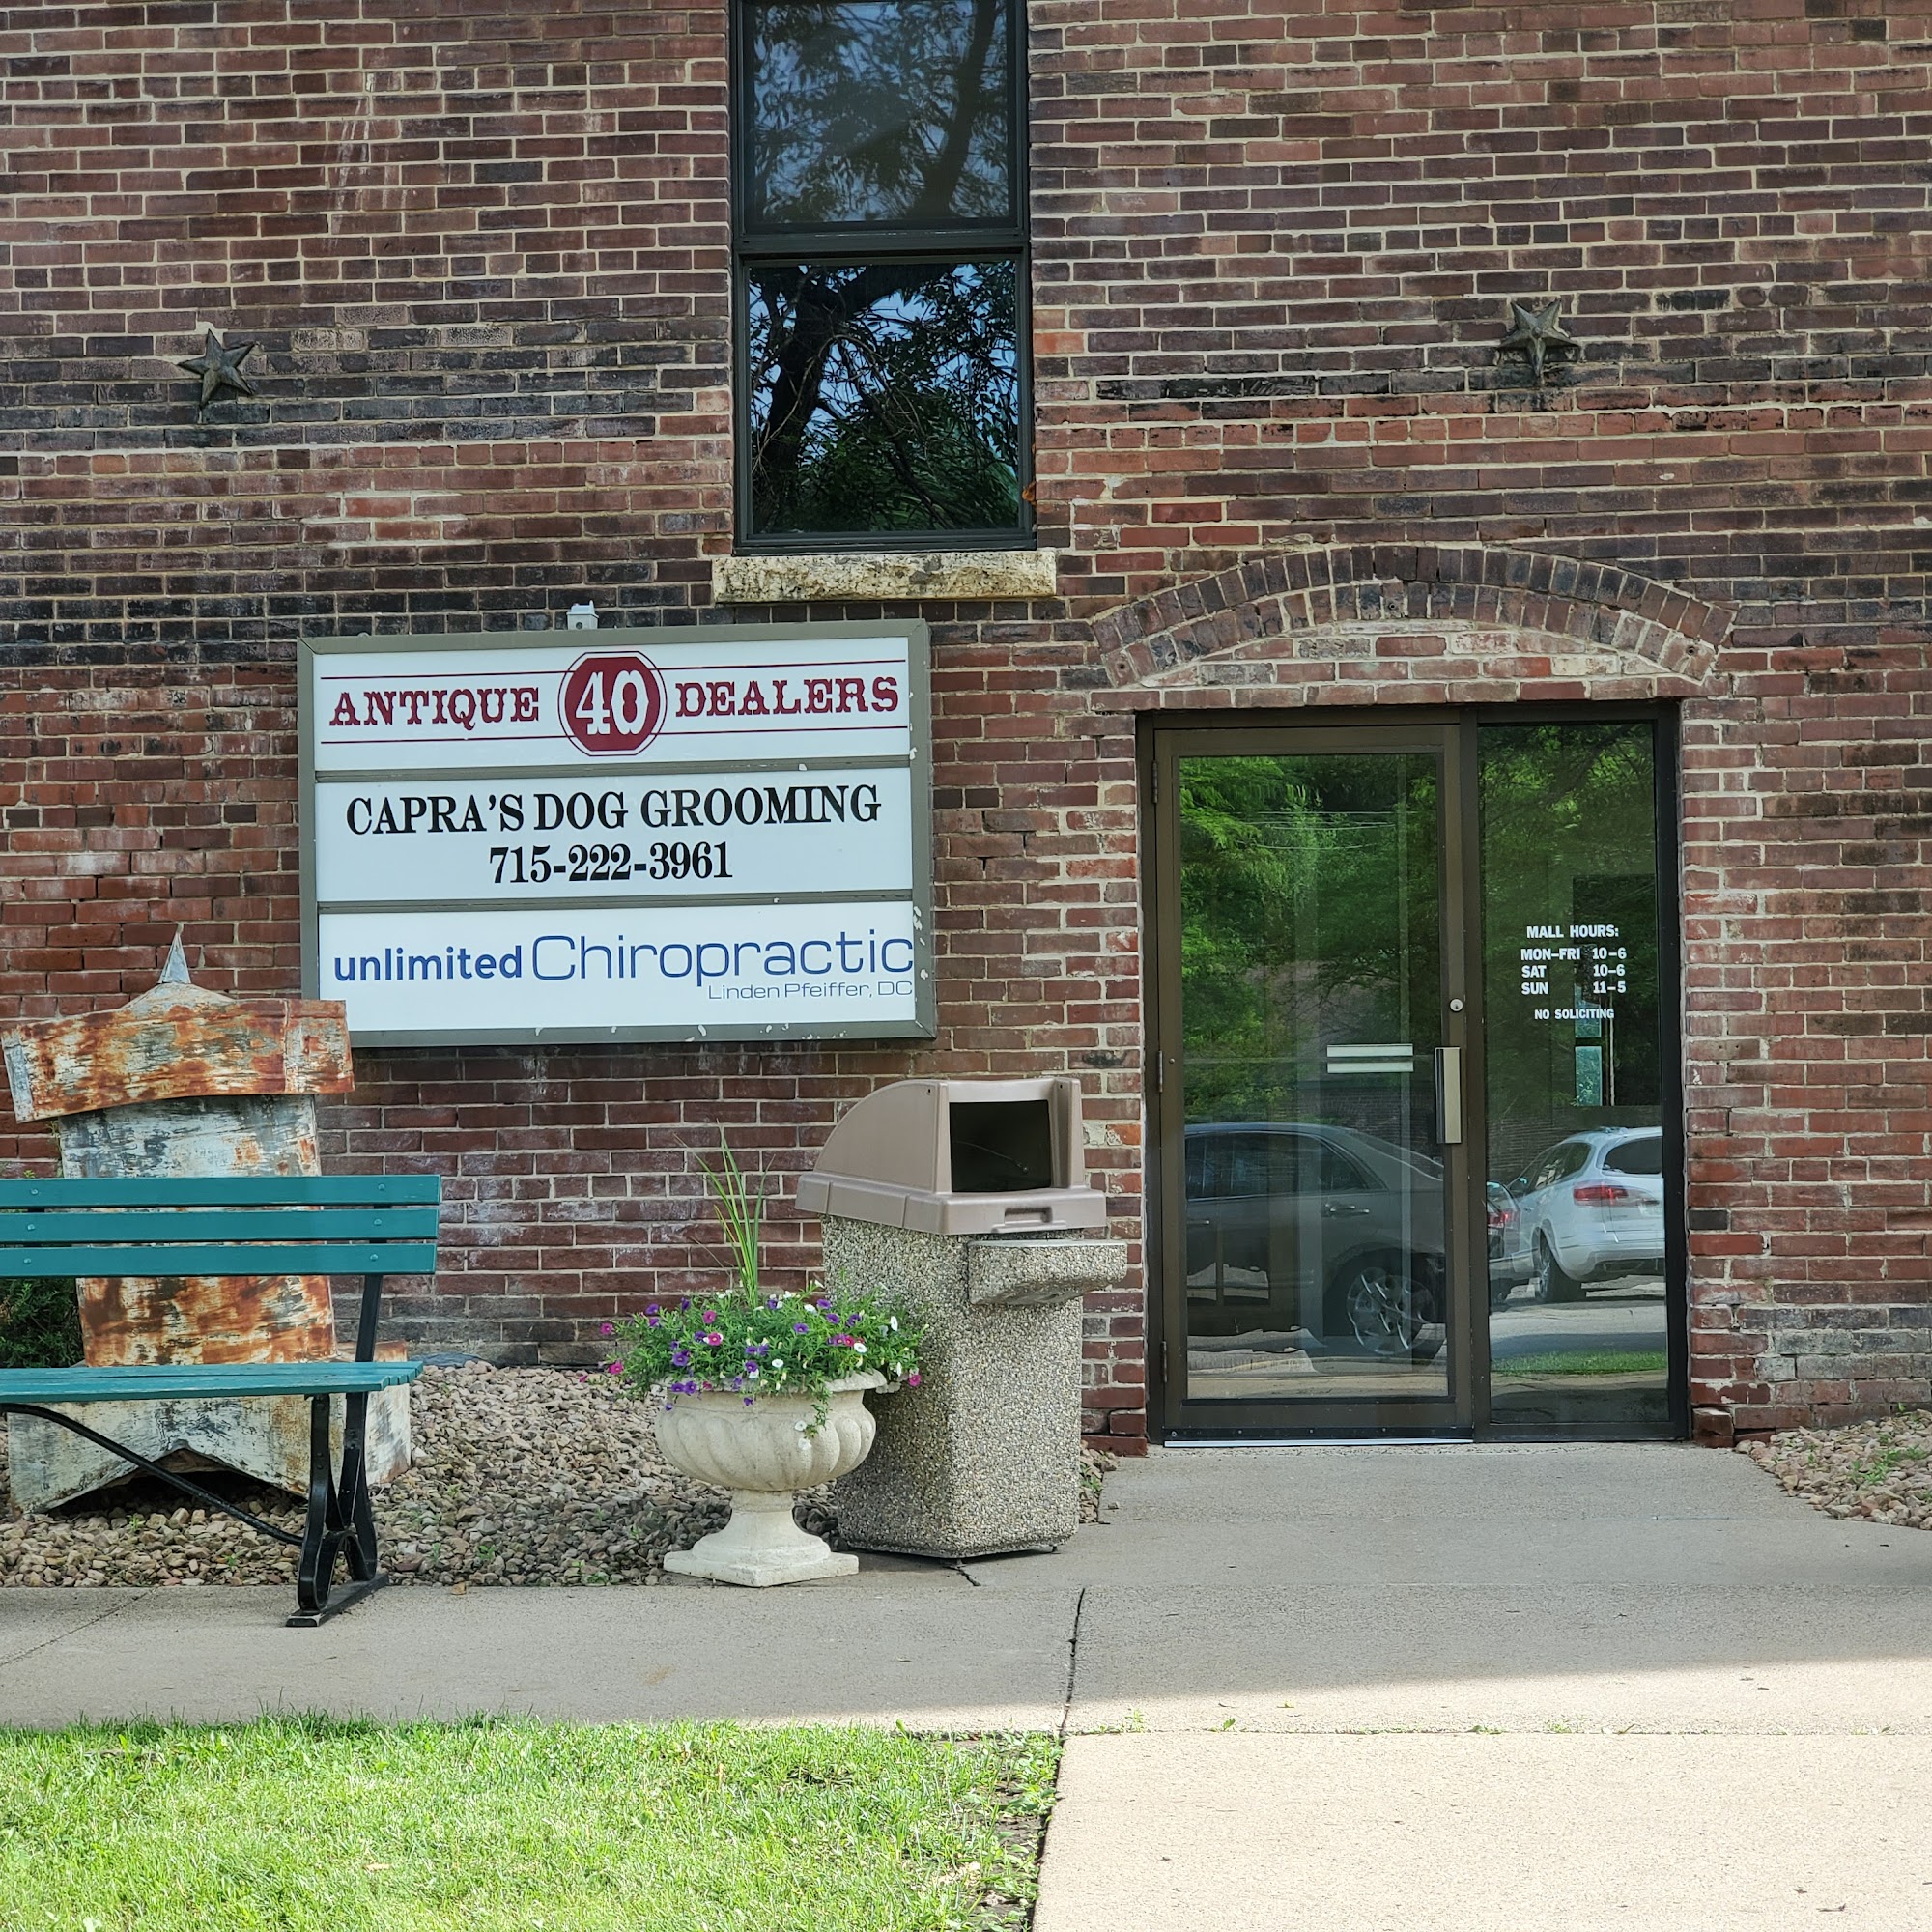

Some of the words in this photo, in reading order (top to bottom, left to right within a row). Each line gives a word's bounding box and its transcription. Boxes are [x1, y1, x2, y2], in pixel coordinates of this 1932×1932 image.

[329, 687, 540, 730] ANTIQUE
[575, 668, 650, 736] 40
[675, 676, 899, 718] DEALERS
[346, 793, 524, 835] CAPRA'S
[533, 791, 629, 831] DOG
[640, 783, 882, 827] GROOMING
[489, 841, 733, 884] 715-222-3961
[1526, 925, 1564, 938] MALL
[1570, 924, 1619, 937] HOURS:
[334, 945, 523, 982] unlimited
[531, 929, 914, 987] Chiropractic
[1521, 965, 1547, 979] SAT
[708, 983, 781, 1000] Linden
[784, 981, 873, 998] Pfeiffer,
[877, 980, 913, 996] DC
[1521, 981, 1548, 995] SUN
[1534, 1009, 1550, 1020] NO
[1554, 1009, 1615, 1020] SOLICITING
